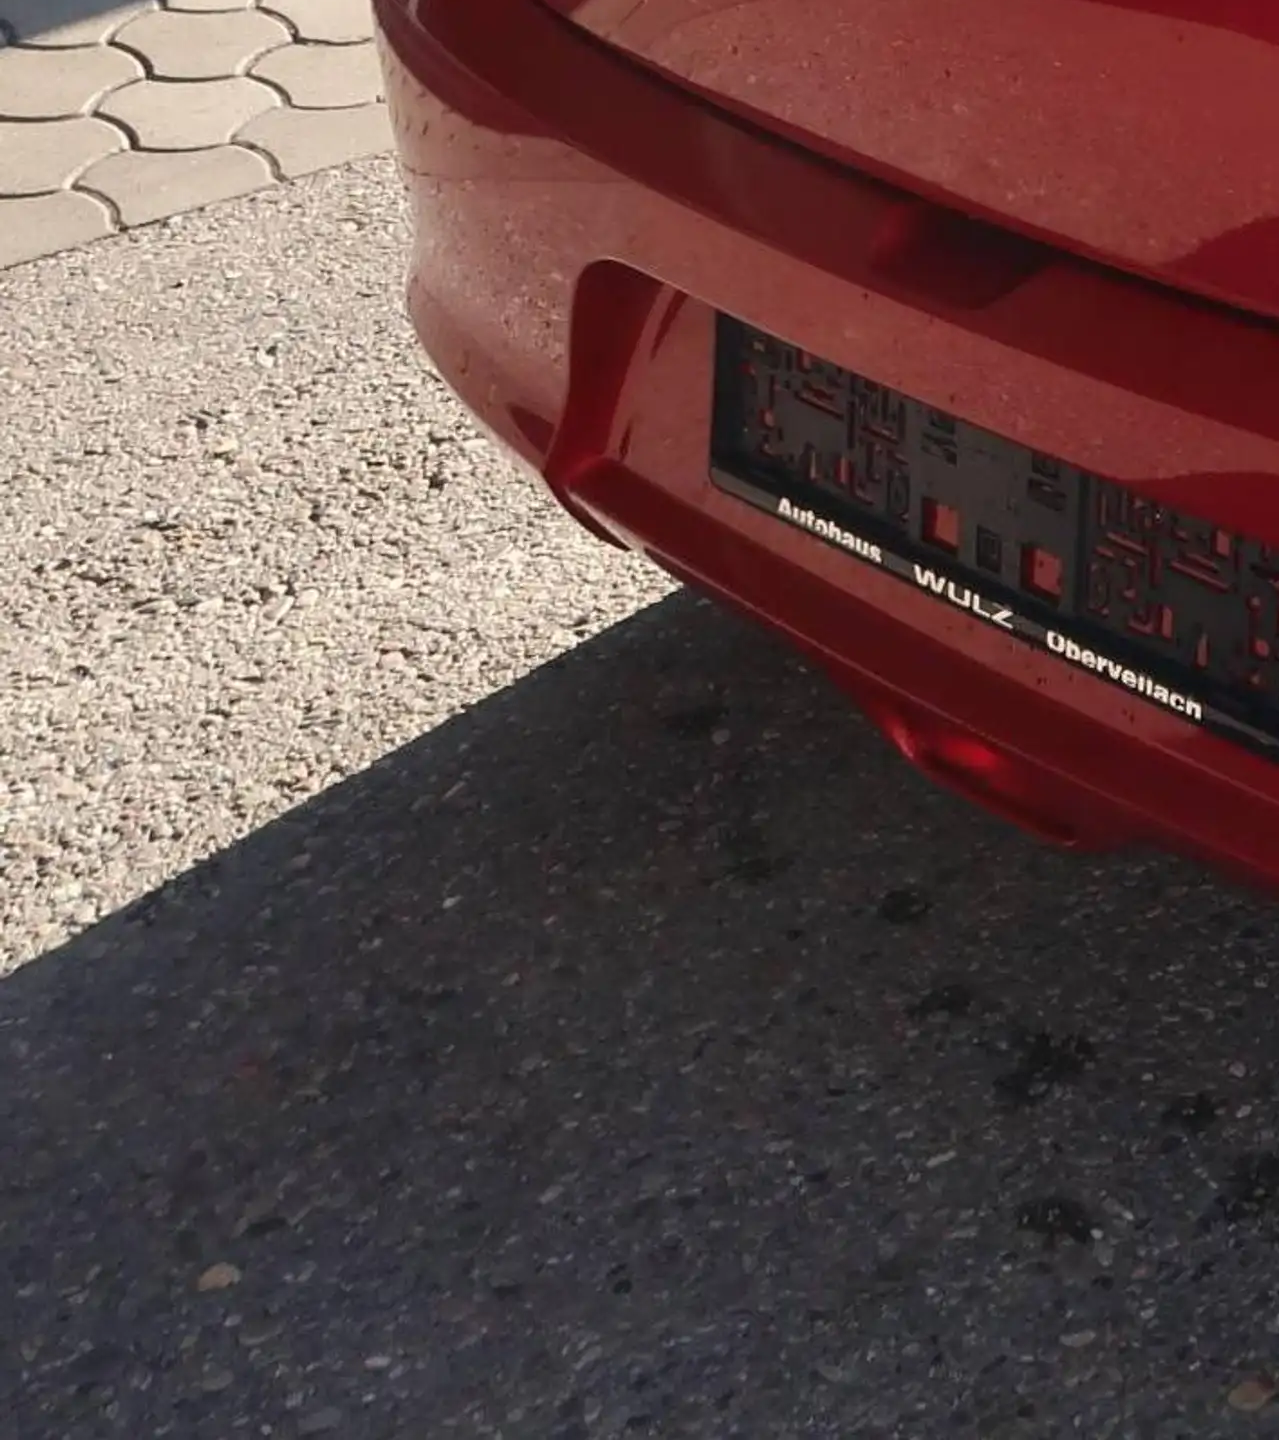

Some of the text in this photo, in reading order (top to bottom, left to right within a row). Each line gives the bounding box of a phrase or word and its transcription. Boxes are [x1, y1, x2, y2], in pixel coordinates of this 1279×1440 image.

[777, 497, 1203, 721] Autohaus WULZ Obervellach
